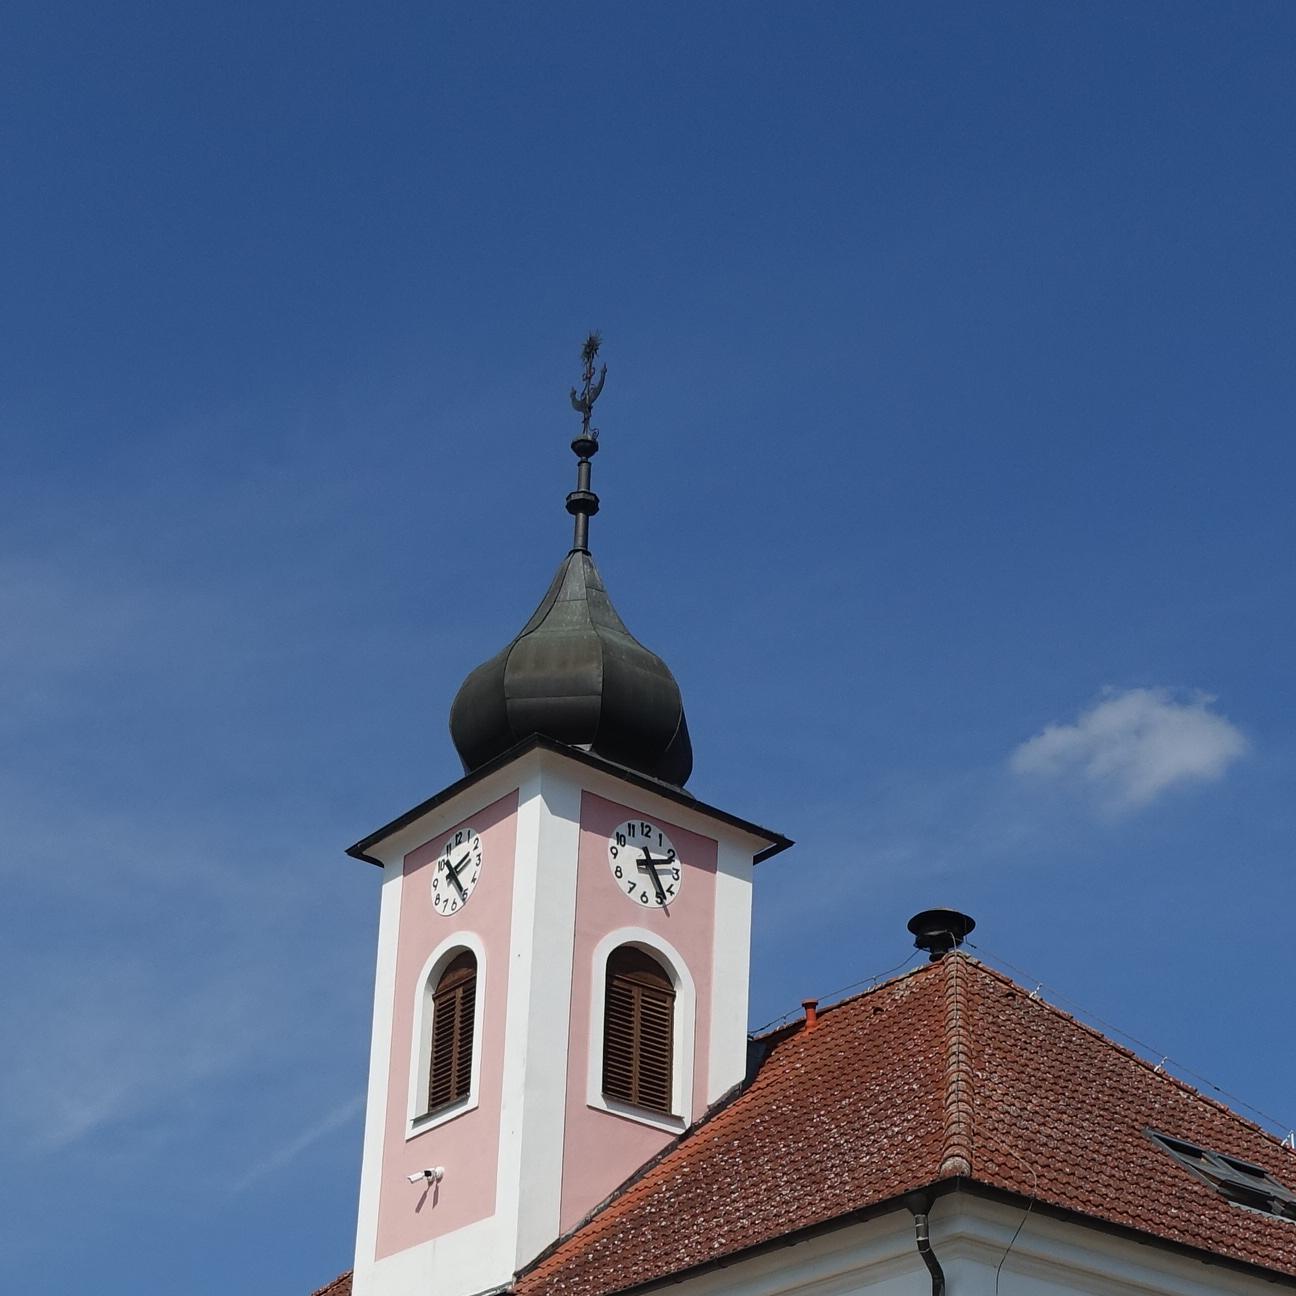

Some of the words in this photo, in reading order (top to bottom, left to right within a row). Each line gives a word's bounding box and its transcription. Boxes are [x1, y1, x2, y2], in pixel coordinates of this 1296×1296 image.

[628, 822, 636, 838] 11
[640, 822, 652, 838] 12
[455, 832, 462, 846] 12
[467, 830, 471, 844] 1
[616, 832, 626, 847] 10
[658, 833, 662, 847] 1
[446, 842, 452, 857] 11
[473, 838, 479, 850] 2
[610, 846, 618, 859] 9
[667, 849, 676, 862] 2
[438, 859, 445, 873] 10
[476, 854, 481, 866] 3
[471, 871, 476, 884] 4
[614, 866, 622, 878] 8
[672, 868, 680, 880] 3
[432, 878, 438, 890] 9
[628, 880, 636, 894] 7
[666, 884, 675, 896] 4
[434, 893, 440, 906] 8
[463, 888, 468, 902] 5
[640, 891, 648, 904] 6
[656, 892, 664, 904] 5
[443, 898, 448, 912] 7
[451, 898, 457, 911] 6
